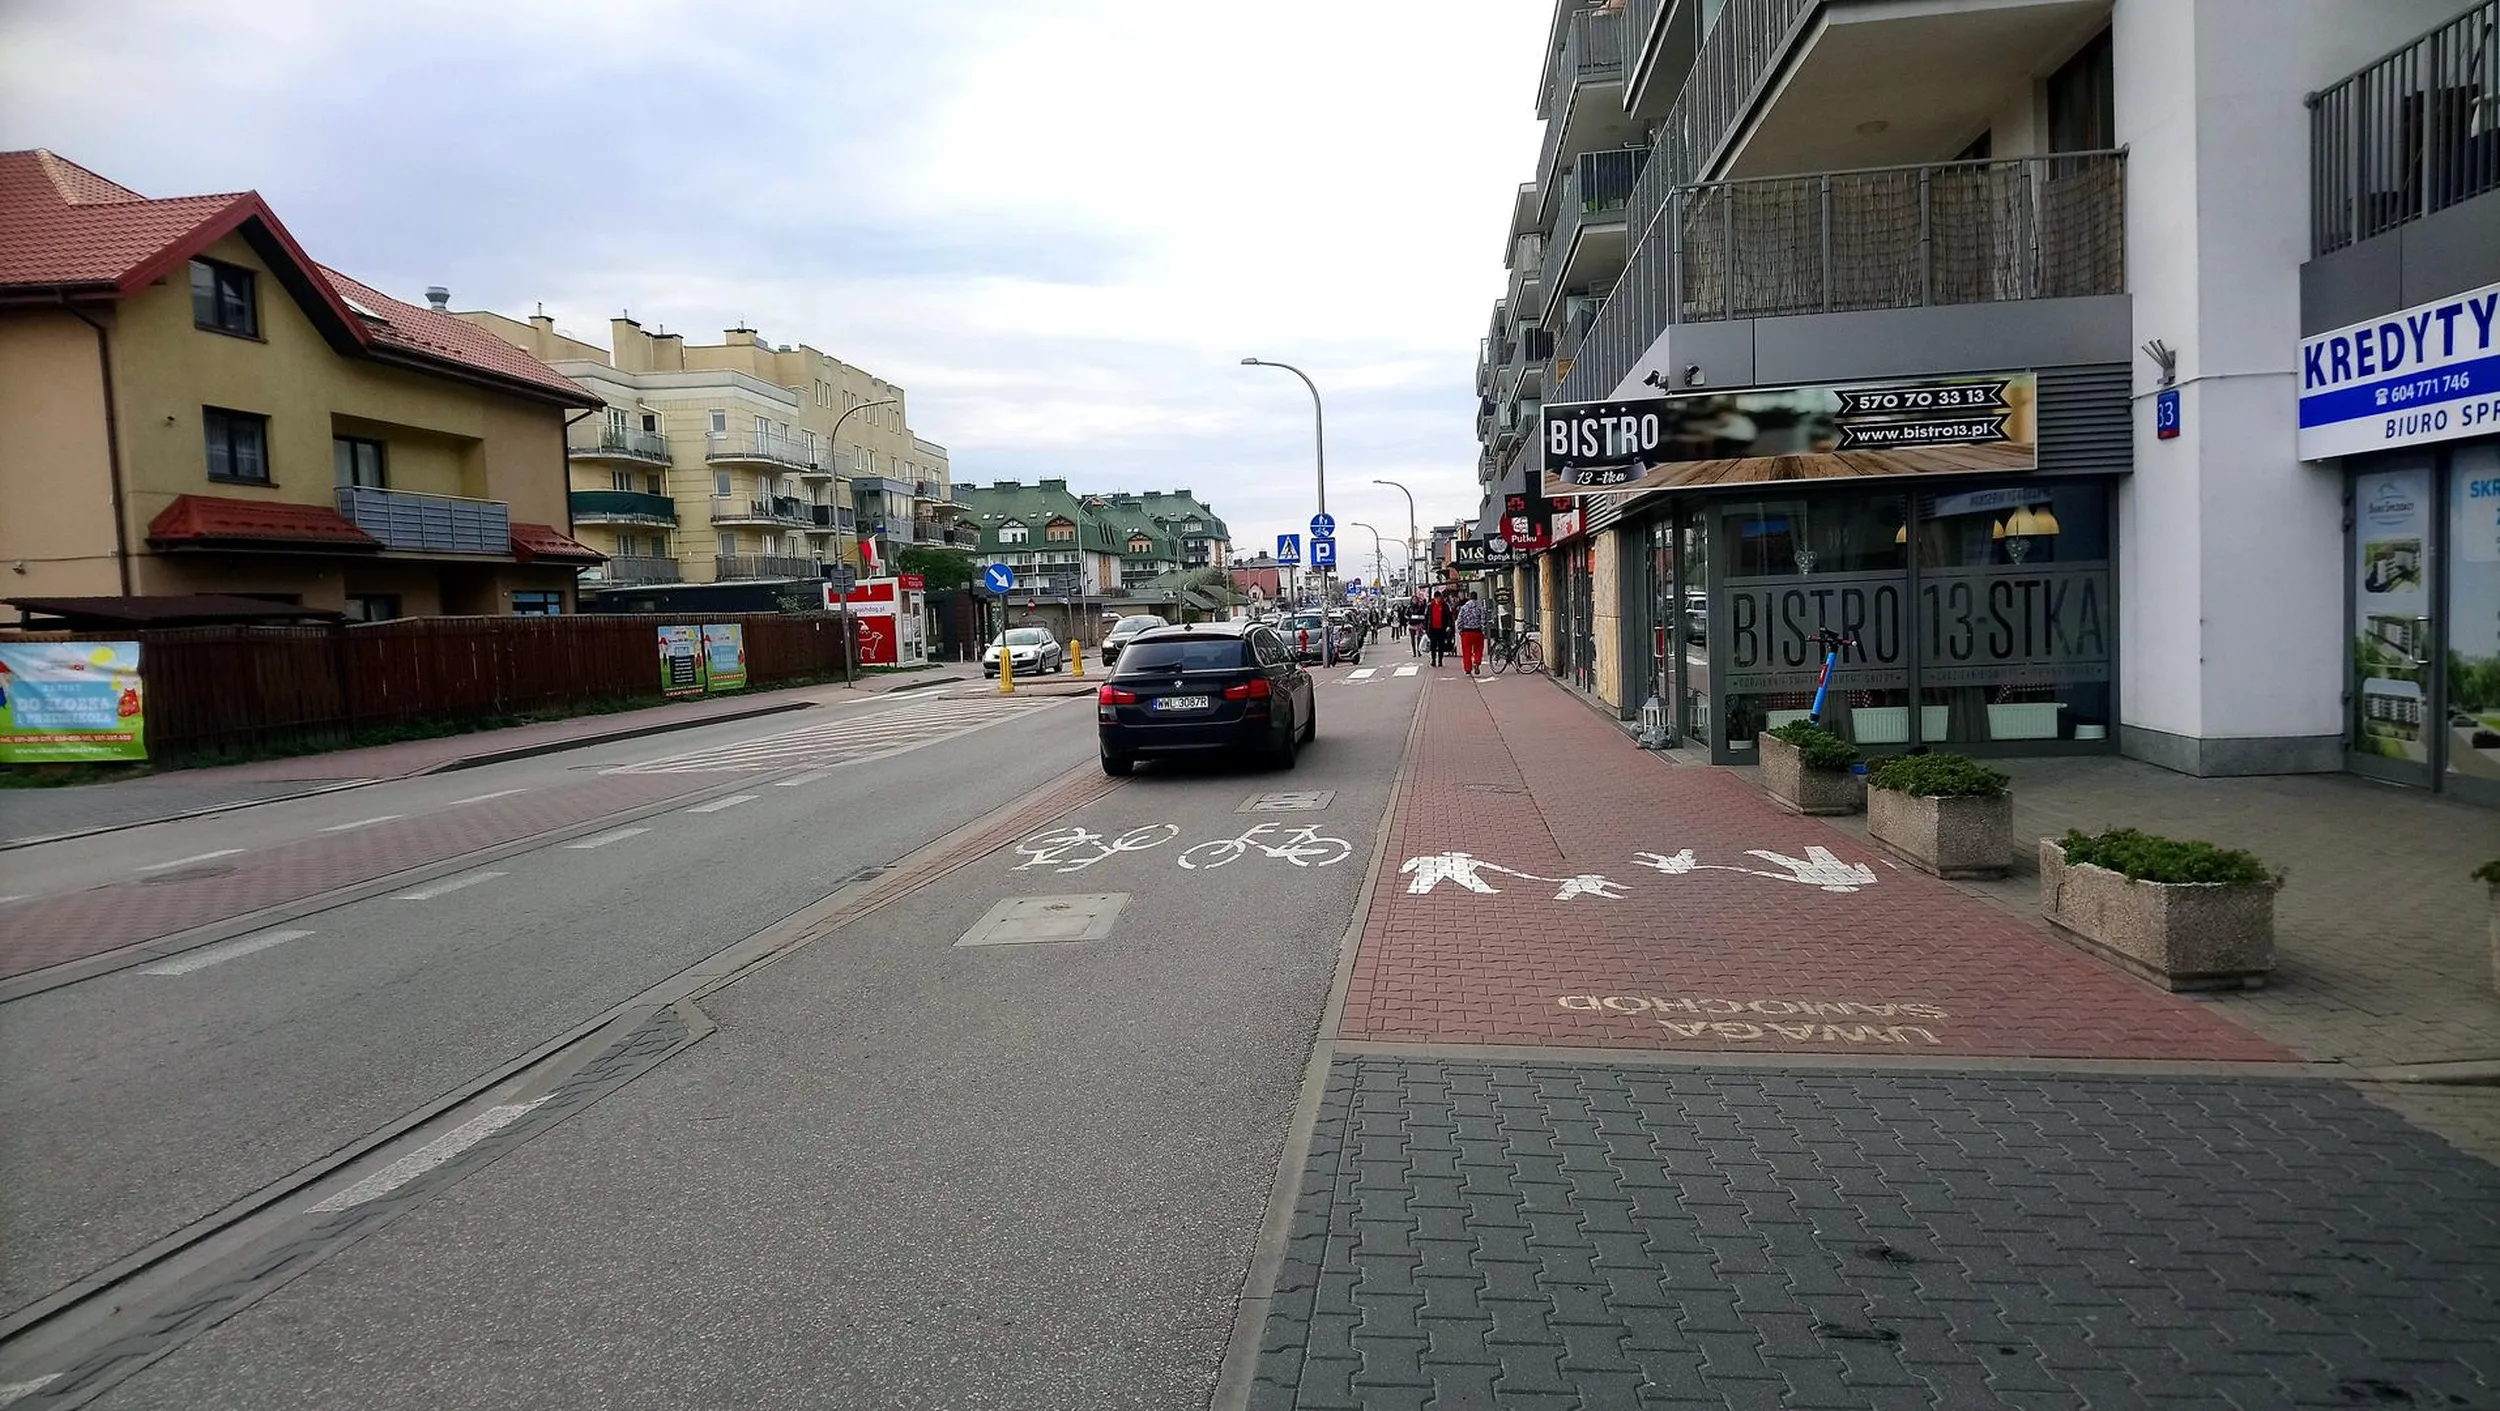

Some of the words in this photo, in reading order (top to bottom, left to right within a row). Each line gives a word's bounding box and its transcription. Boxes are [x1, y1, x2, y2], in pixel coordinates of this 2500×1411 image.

[2304, 292, 2499, 390] KREDYTY
[1858, 395, 1899, 410] 570
[1904, 392, 1932, 407] 70
[1938, 391, 1960, 405] 33
[1965, 389, 1985, 403] 13
[2391, 384, 2415, 403] 604
[2417, 379, 2438, 397] 771
[2442, 371, 2470, 392] 746
[1550, 413, 1659, 458] BISTRO
[1856, 422, 1988, 441] www.bistro13.pl
[2385, 409, 2448, 439] BIURO
[1576, 471, 1594, 485] 13
[1316, 543, 1330, 562] P
[1732, 584, 1900, 668] BISTRO
[1922, 576, 2105, 660] 13-STKA
[1556, 995, 1949, 1020] SAMOCHÓD
[1654, 1018, 1941, 1045] UWAGA
